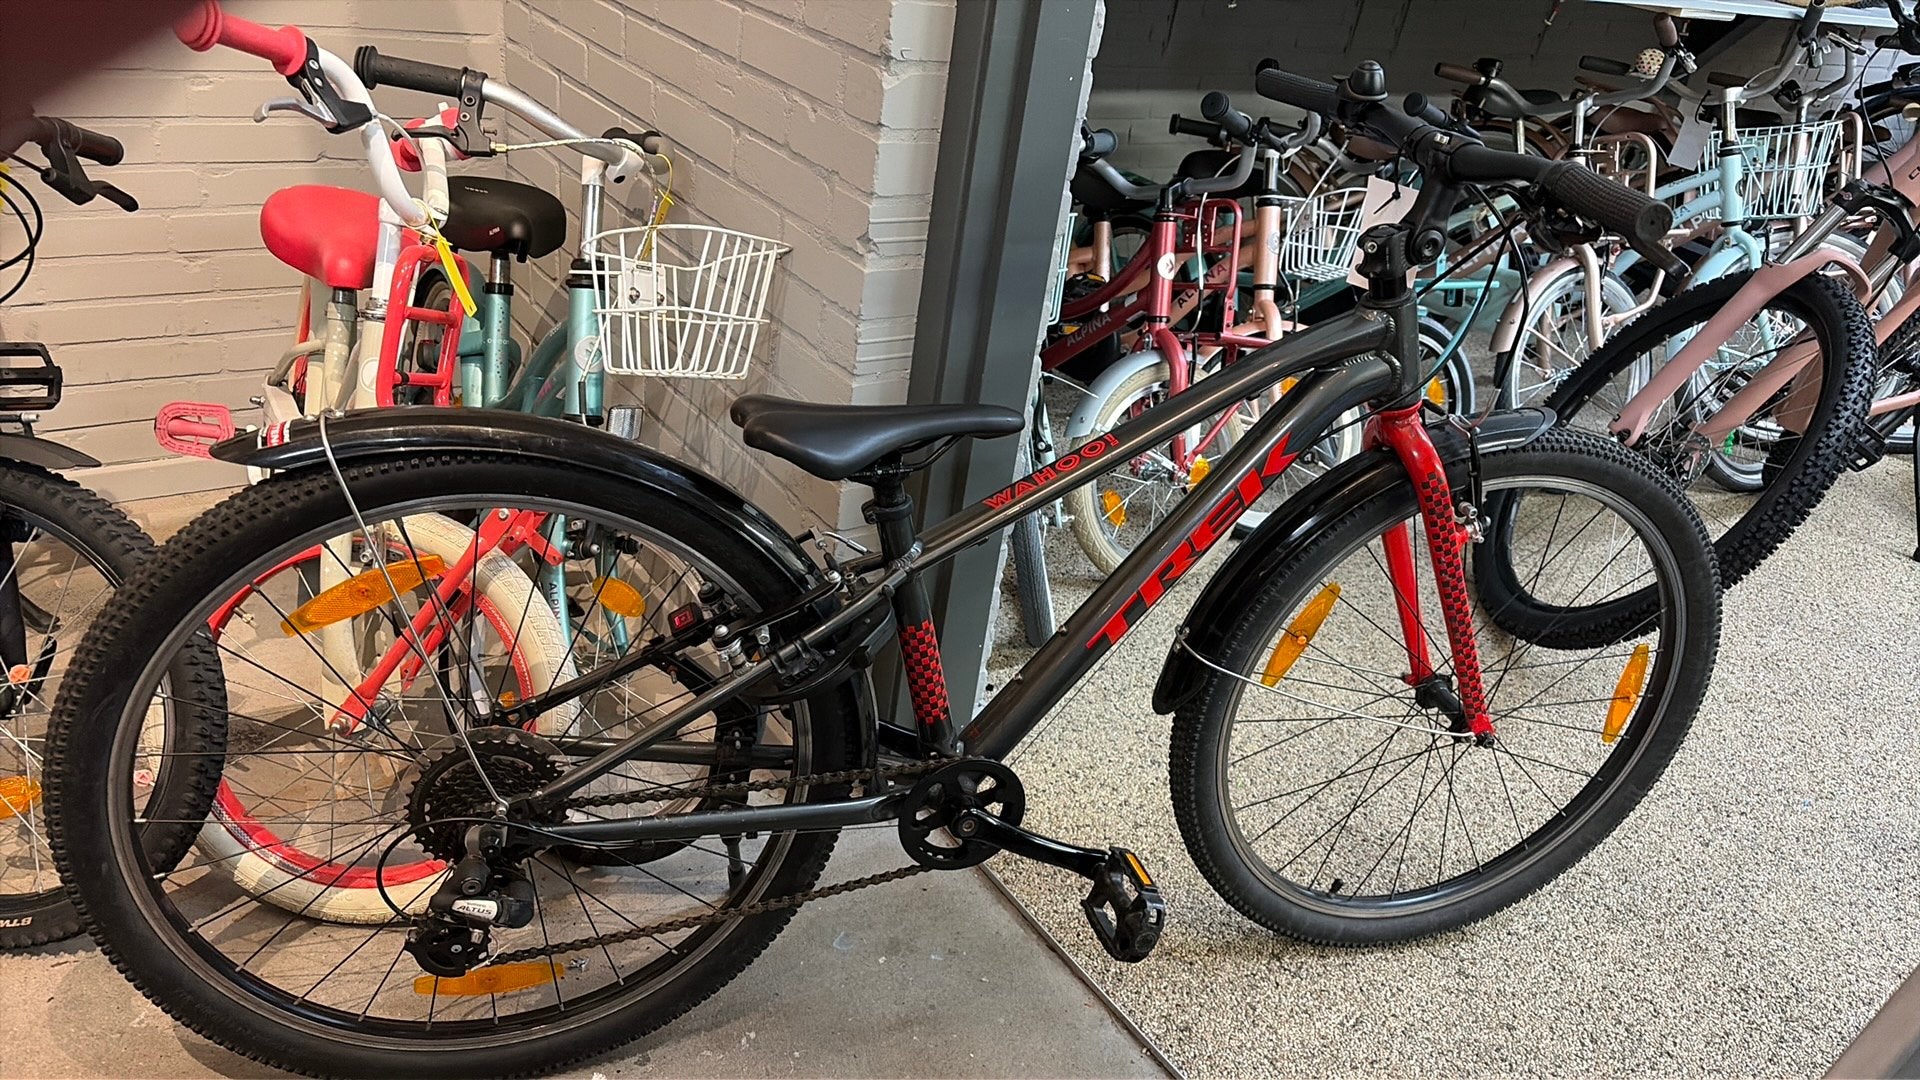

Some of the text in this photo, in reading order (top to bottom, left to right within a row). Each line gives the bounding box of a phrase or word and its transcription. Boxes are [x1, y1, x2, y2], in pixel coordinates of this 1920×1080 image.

[1177, 264, 1227, 309] ALNA
[1066, 313, 1112, 347] ALPINA
[982, 433, 1120, 511] WAHOO!
[1085, 431, 1300, 649] TREK
[456, 905, 493, 916] ALTUS
